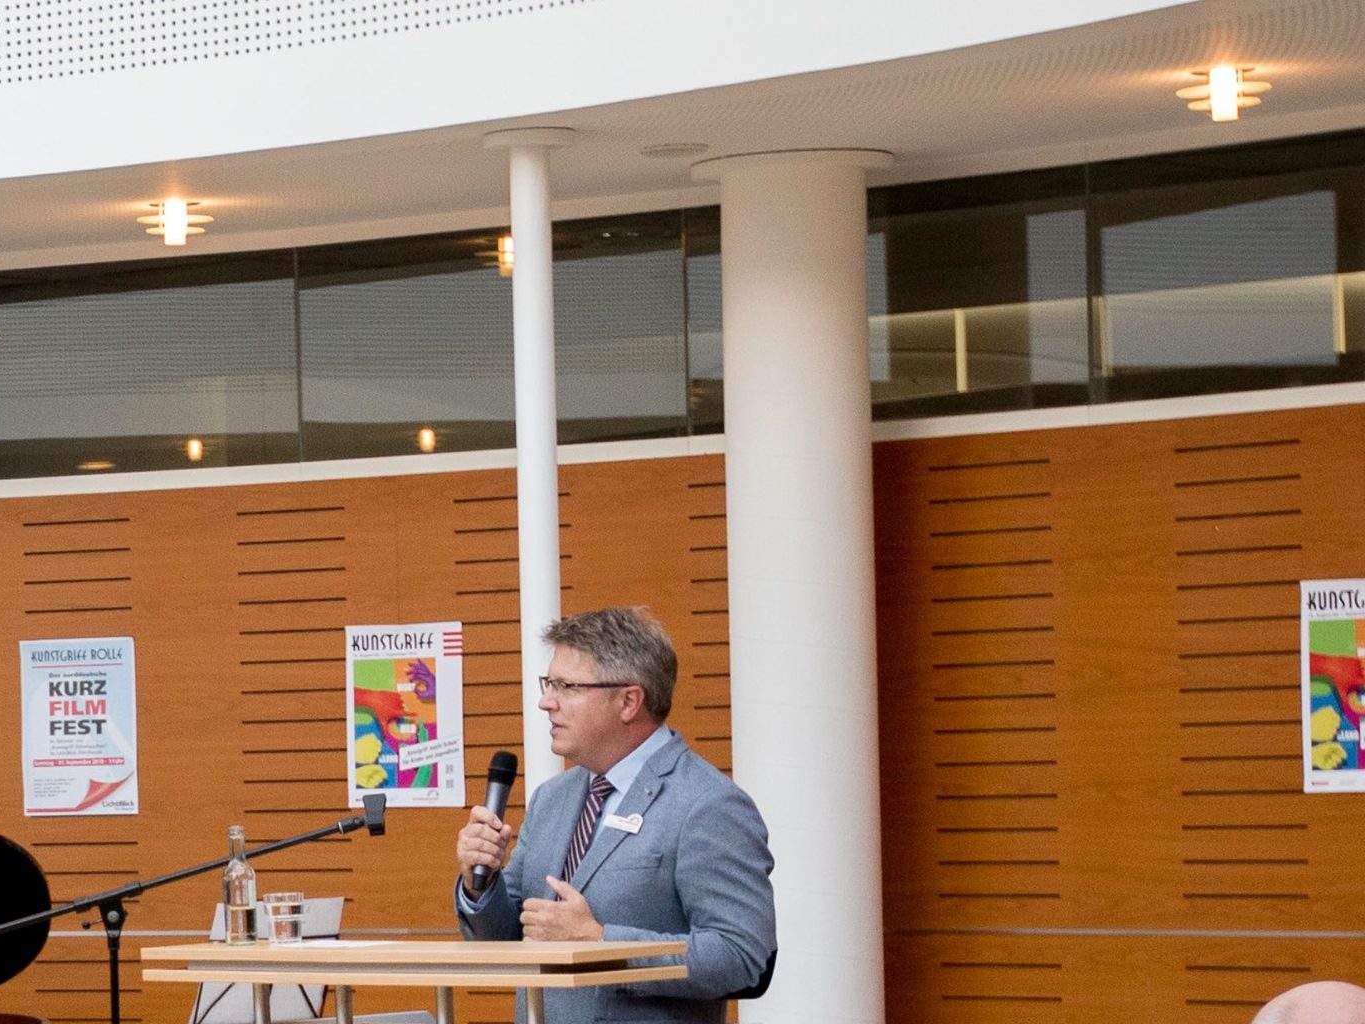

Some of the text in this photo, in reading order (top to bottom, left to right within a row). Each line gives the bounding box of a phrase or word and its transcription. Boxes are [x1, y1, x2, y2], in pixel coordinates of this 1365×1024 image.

[351, 632, 434, 652] KUNSTGRIFF
[31, 648, 124, 663] KUNSTGRIFF ROLLE
[49, 679, 108, 697] KURZ
[49, 698, 107, 717] FILM
[49, 719, 108, 736] FEST
